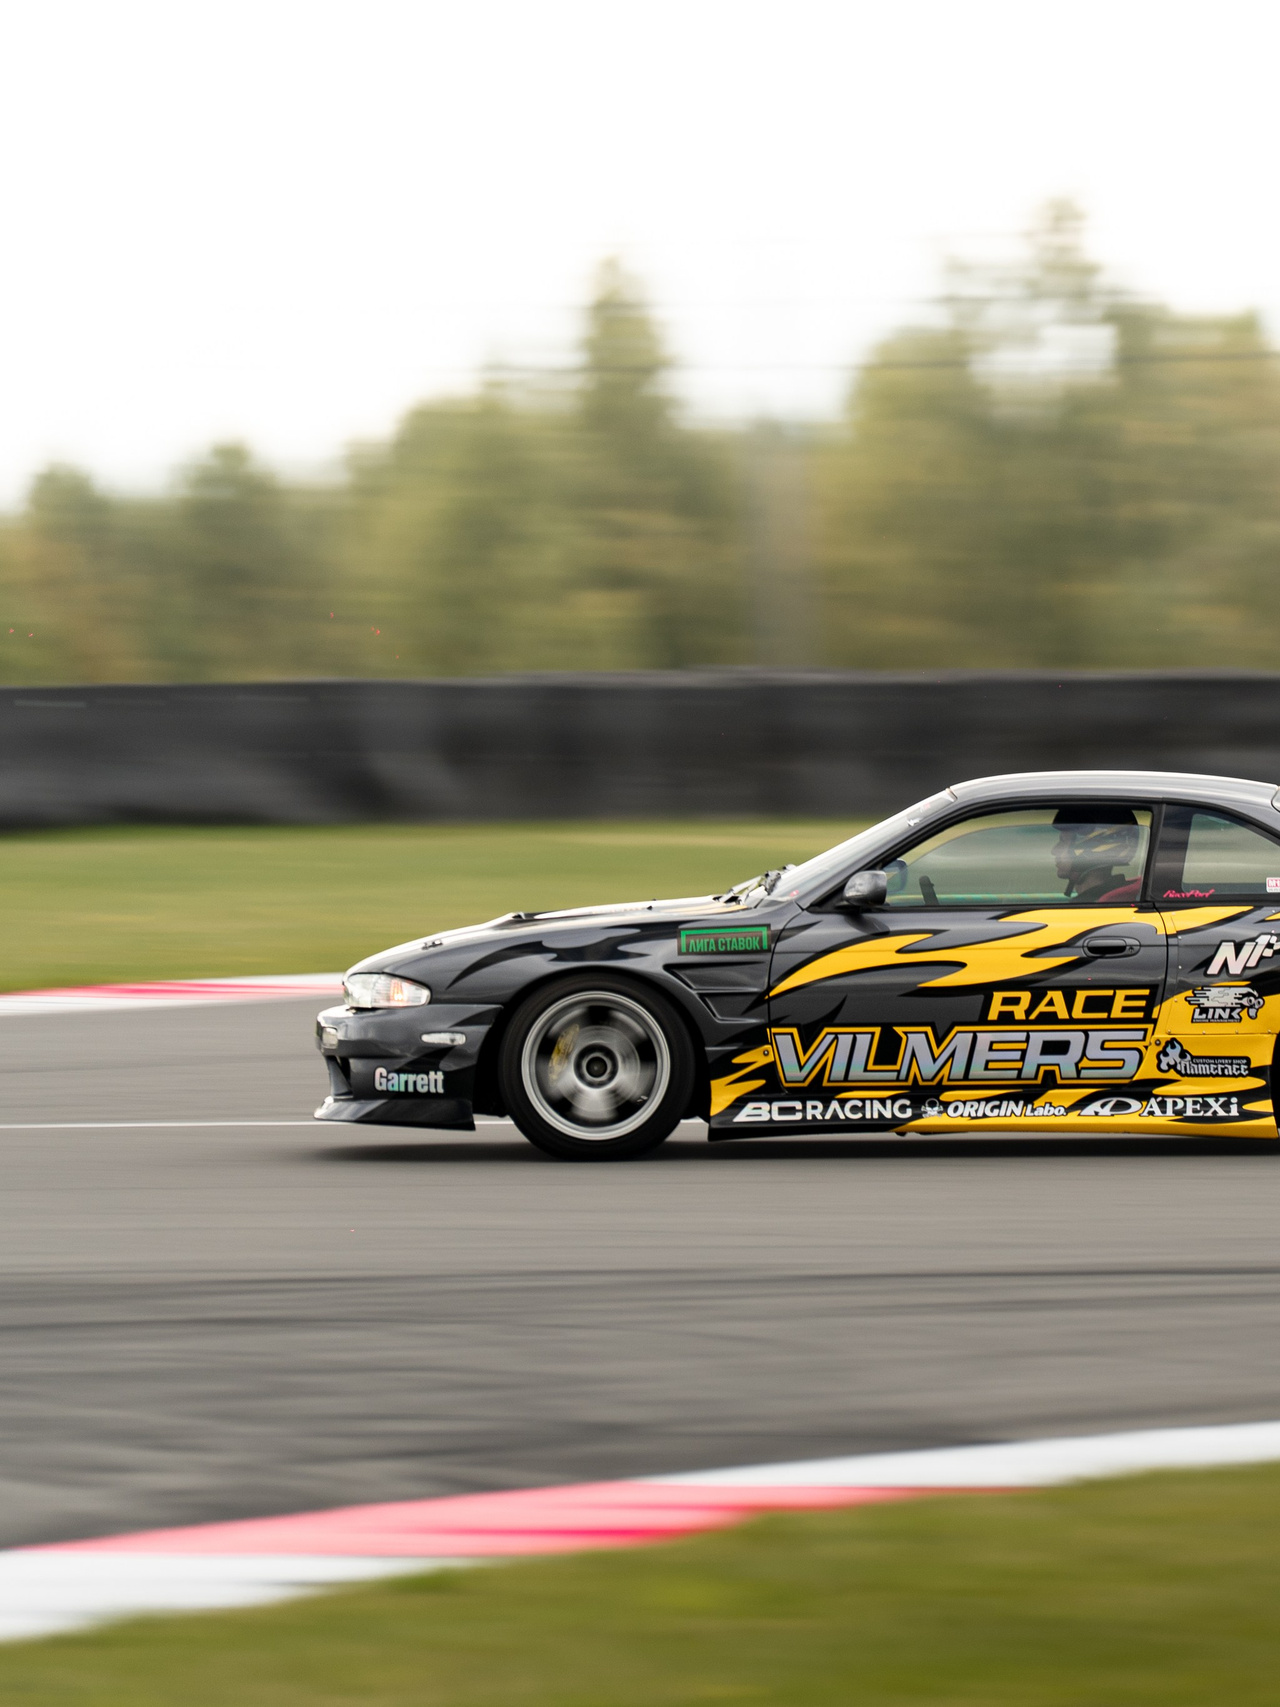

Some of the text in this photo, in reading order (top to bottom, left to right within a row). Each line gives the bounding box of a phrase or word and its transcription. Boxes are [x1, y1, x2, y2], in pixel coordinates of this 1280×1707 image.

[689, 936, 760, 952] ЛИГА СТАВОК
[987, 989, 1151, 1020] RACE
[1193, 1008, 1242, 1019] LINK
[772, 1030, 1149, 1083] VILMERS
[374, 1066, 445, 1094] Garrett
[732, 1099, 913, 1123] BC RACING
[947, 1100, 1067, 1117] ORIGIN Labo.
